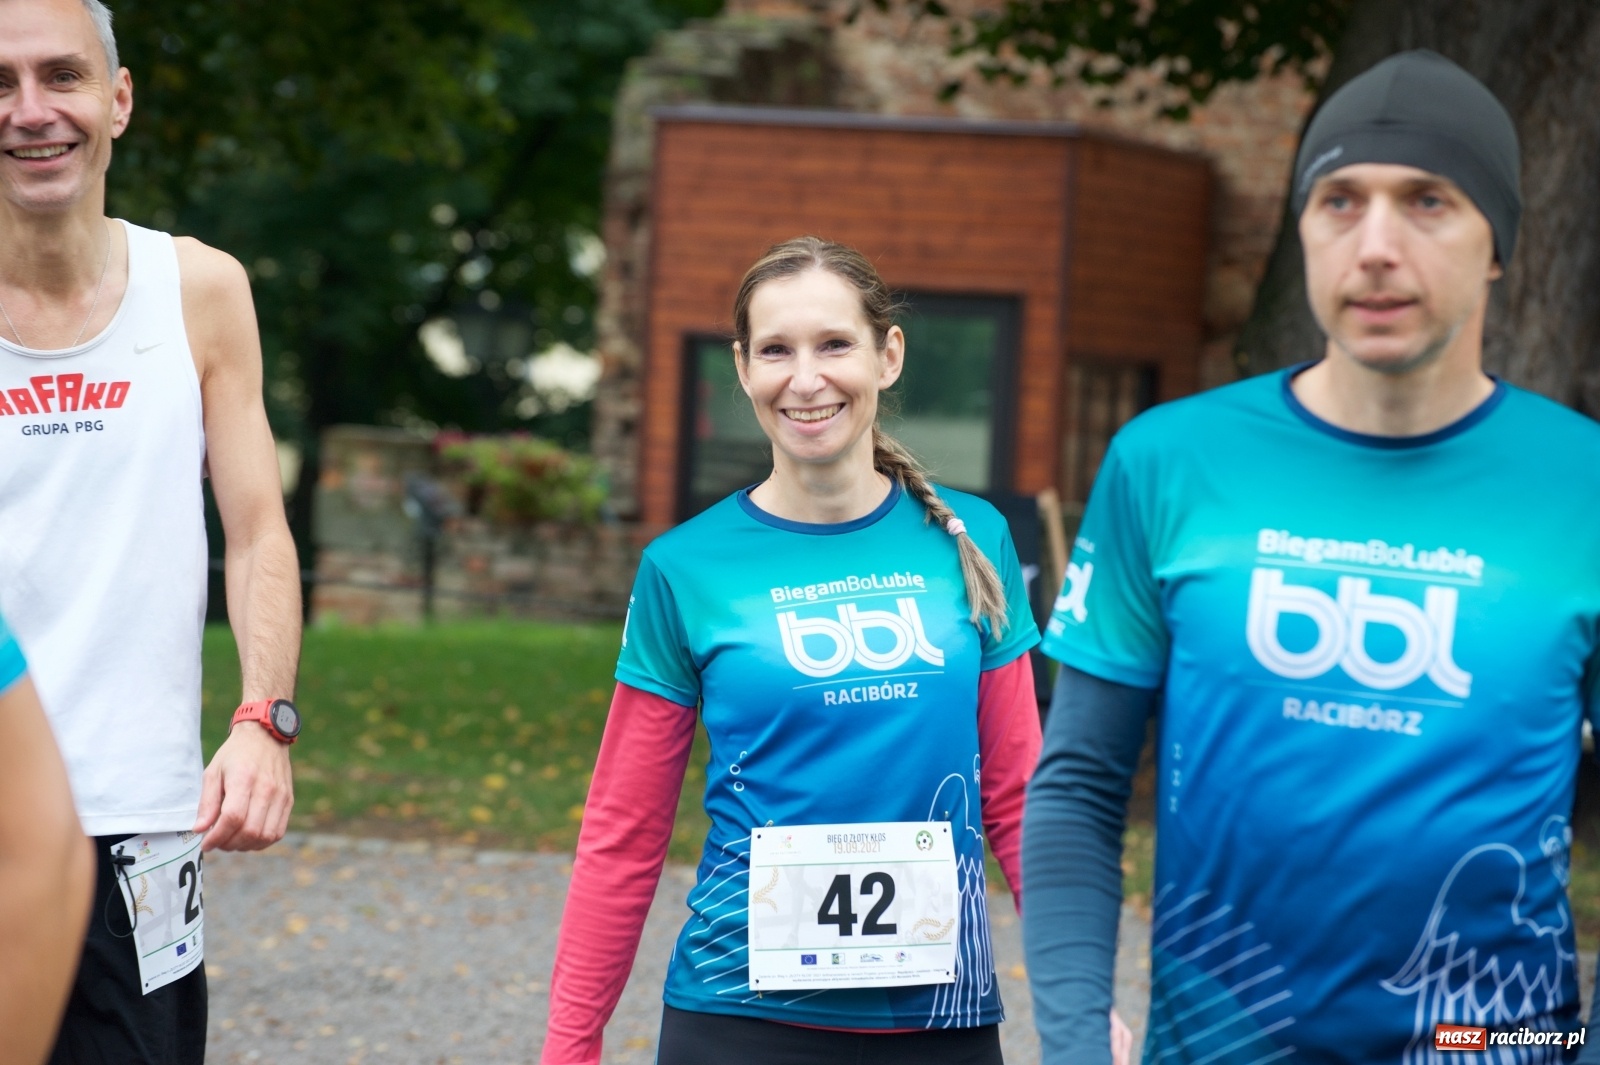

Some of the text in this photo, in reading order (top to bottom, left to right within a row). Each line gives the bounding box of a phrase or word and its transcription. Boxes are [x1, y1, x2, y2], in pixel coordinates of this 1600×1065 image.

[21, 419, 104, 436] GRUPA PBG
[1257, 528, 1485, 580] BiegamBoLubię
[770, 571, 926, 603] BiegamBoLubię
[776, 597, 945, 678] bbl
[1245, 567, 1474, 699] bbl
[823, 680, 919, 706] RACIBÓRZ
[1282, 696, 1424, 737] RACIBÓRZ
[833, 841, 881, 854] 19.09.2021
[817, 871, 897, 936] 42
